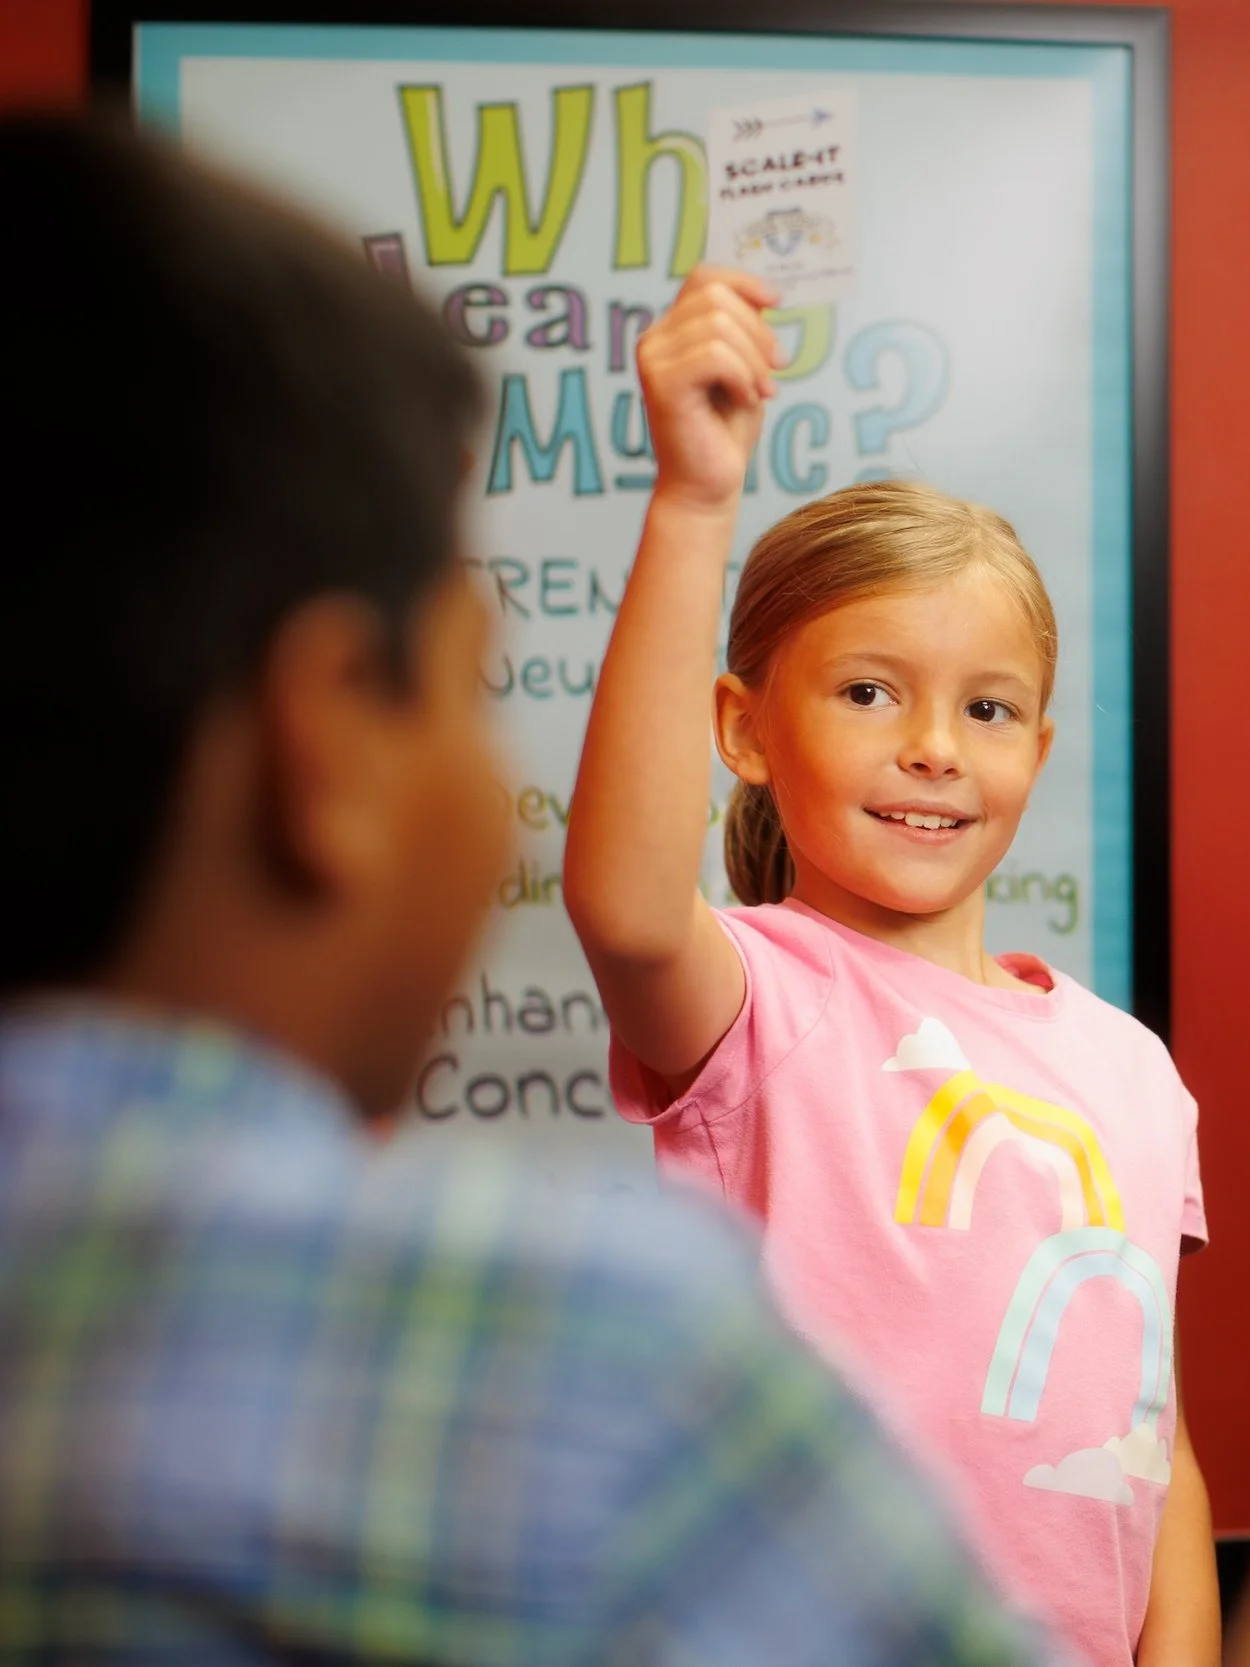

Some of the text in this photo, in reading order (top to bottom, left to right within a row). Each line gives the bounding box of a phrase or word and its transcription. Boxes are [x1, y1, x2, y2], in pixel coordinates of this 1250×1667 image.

[361, 233, 662, 374] ear
[441, 971, 608, 1037] nhan
[416, 1052, 612, 1121] Conc
